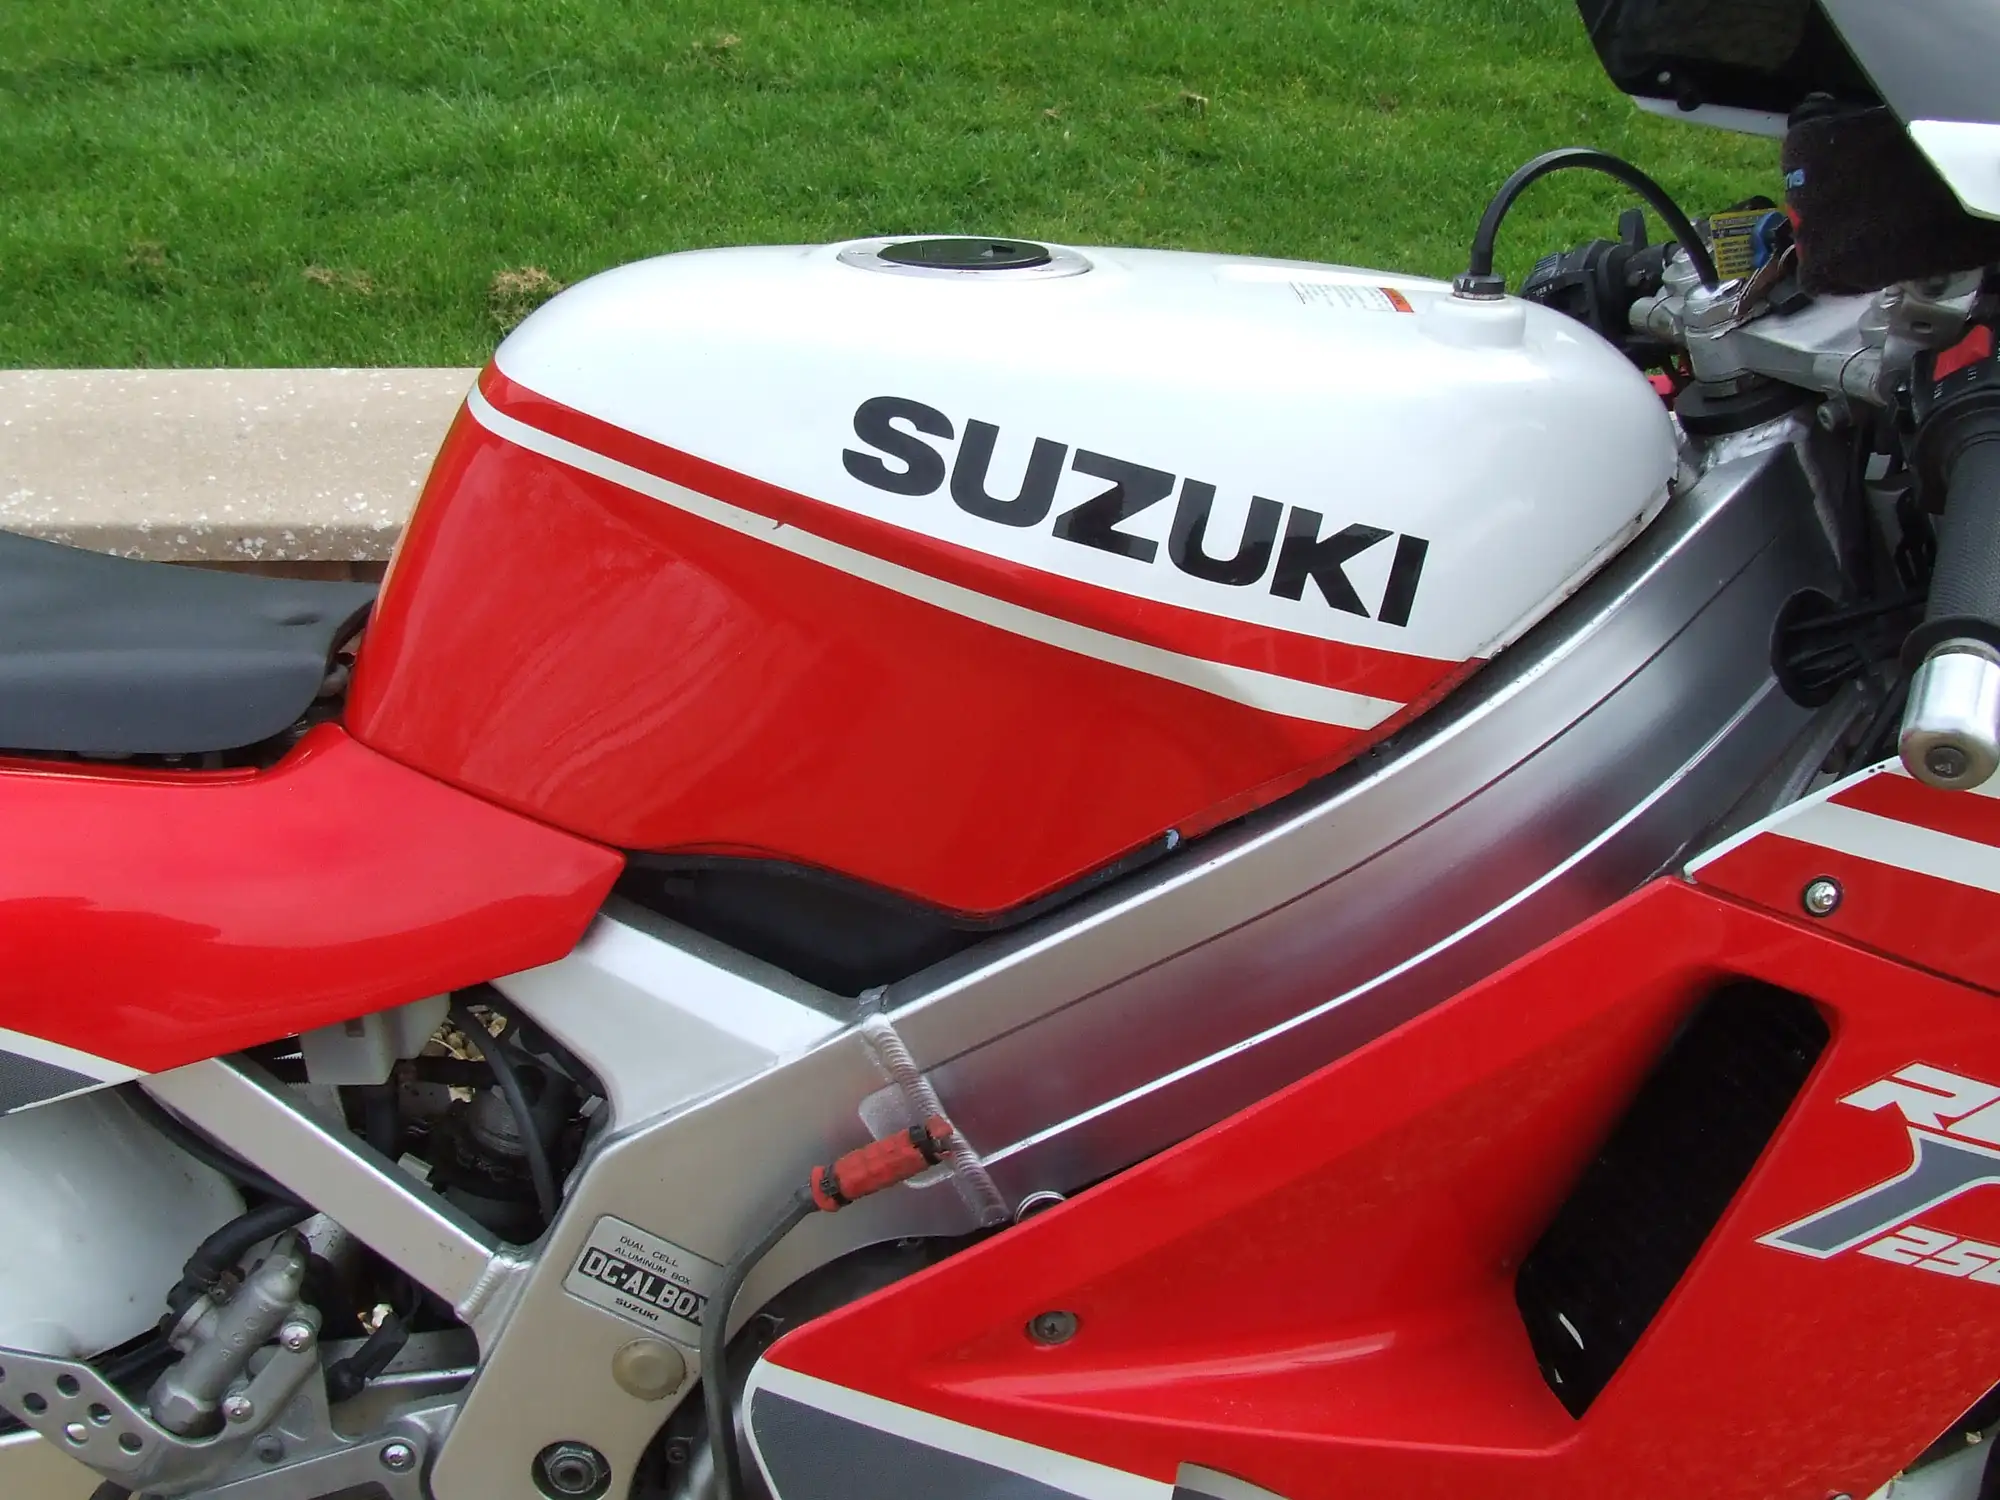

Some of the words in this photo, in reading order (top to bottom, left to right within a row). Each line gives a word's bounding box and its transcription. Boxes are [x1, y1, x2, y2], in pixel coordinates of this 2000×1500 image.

[842, 396, 1429, 627] SUZUKI
[614, 1247, 667, 1275] ALUMINUM
[671, 1271, 691, 1286] BOX
[619, 1235, 645, 1253] DUAL
[652, 1251, 679, 1268] CELL
[615, 1297, 660, 1322] SUZUKI
